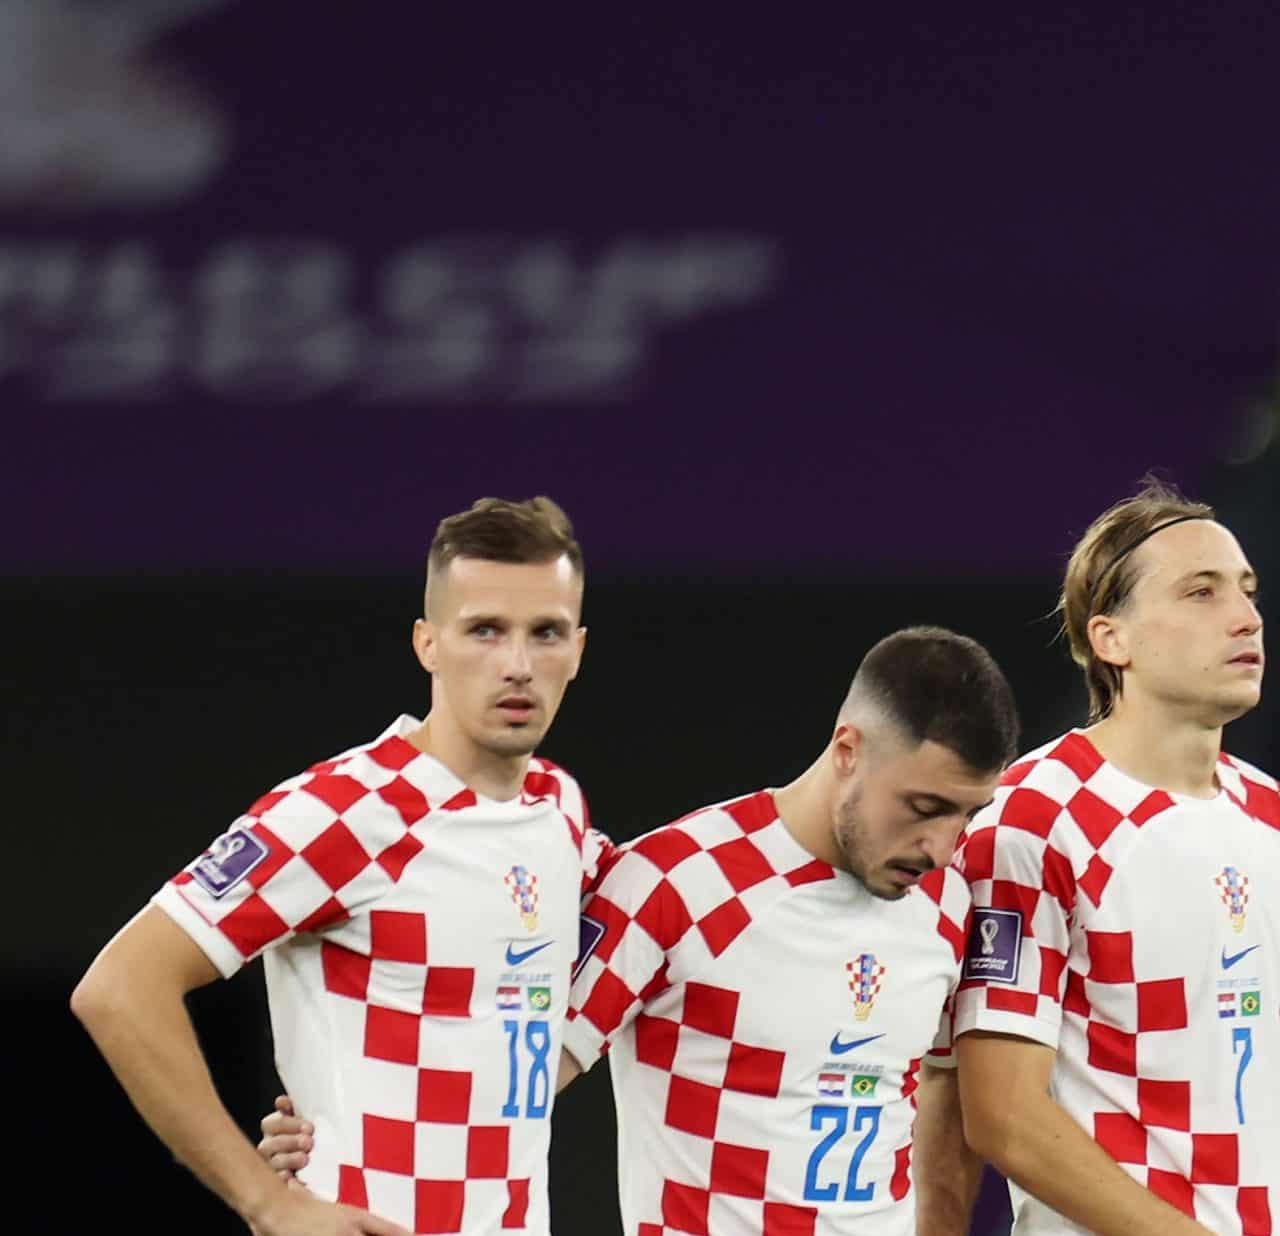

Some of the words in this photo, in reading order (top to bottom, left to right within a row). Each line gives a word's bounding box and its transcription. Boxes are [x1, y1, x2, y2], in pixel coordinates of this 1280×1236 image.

[502, 1020, 551, 1119] 18
[1232, 1028, 1253, 1125] 7
[803, 1105, 882, 1202] 22
